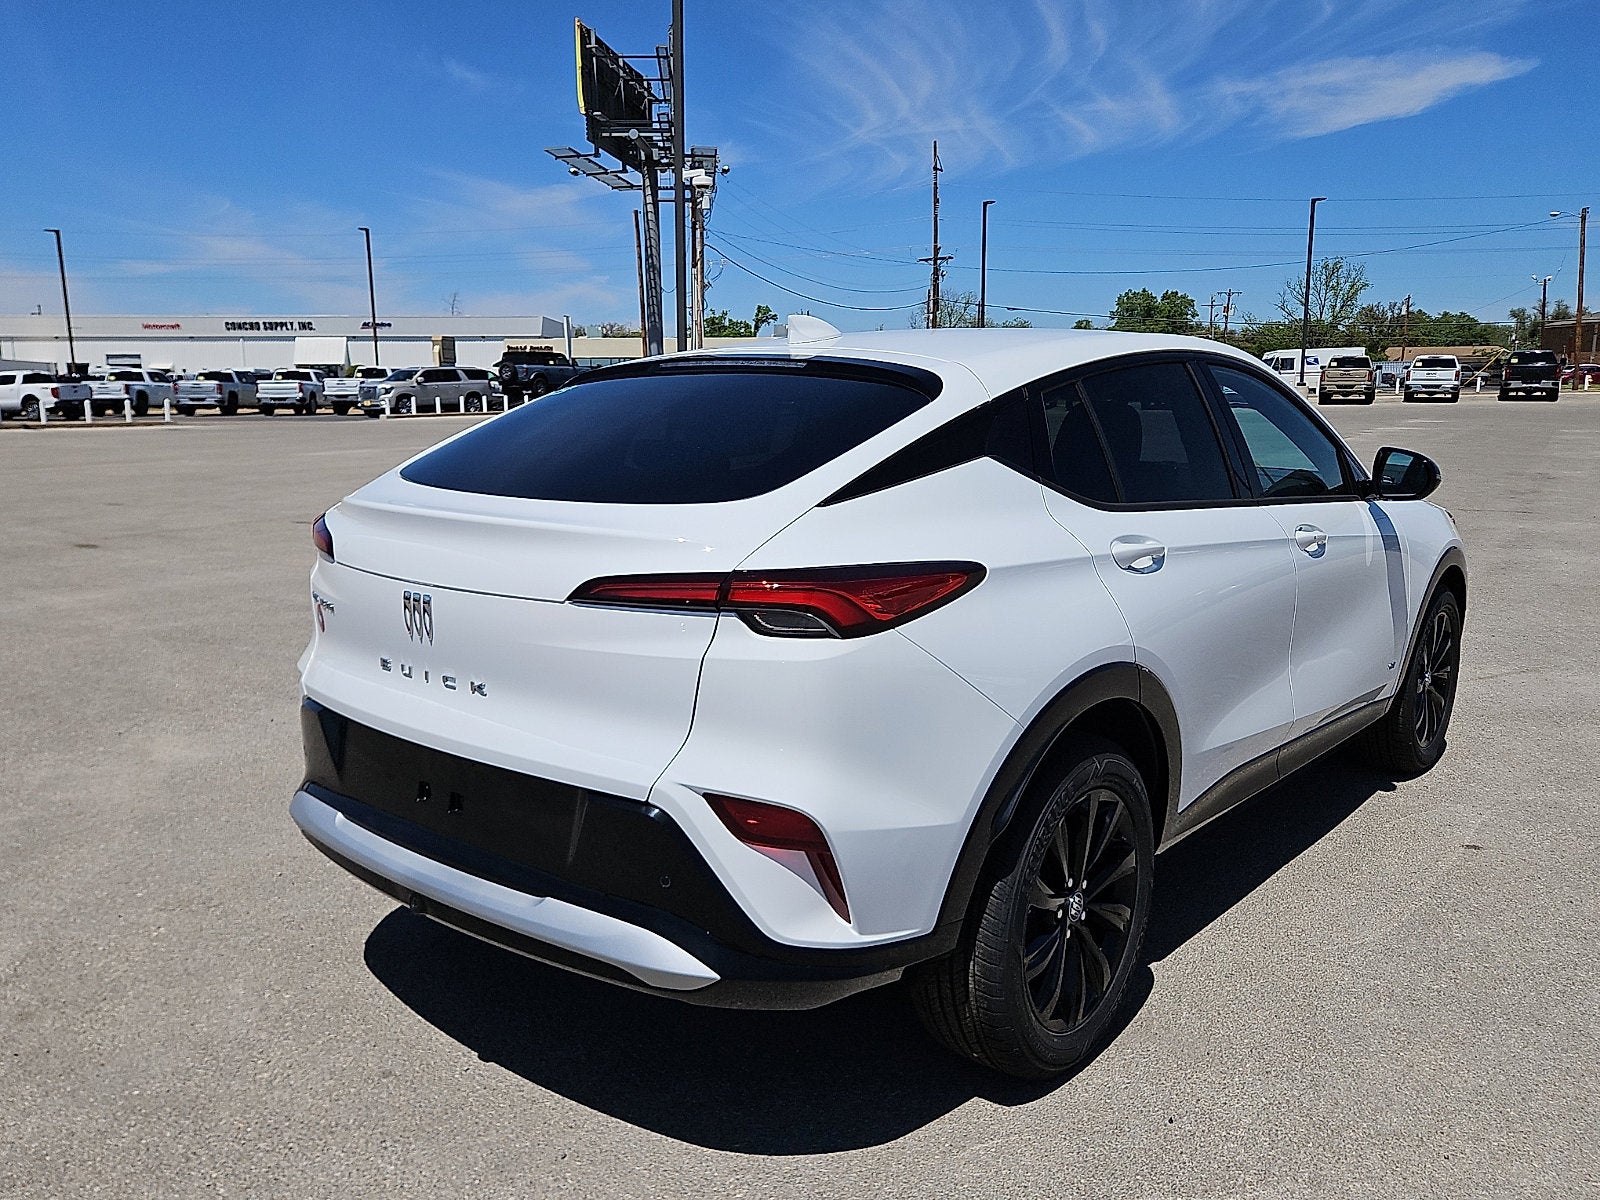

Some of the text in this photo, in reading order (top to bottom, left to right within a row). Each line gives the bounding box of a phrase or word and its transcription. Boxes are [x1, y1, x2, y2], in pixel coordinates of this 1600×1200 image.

[224, 321, 261, 331] CONCHO
[297, 321, 316, 331] INC.
[379, 656, 488, 697] BUICK
